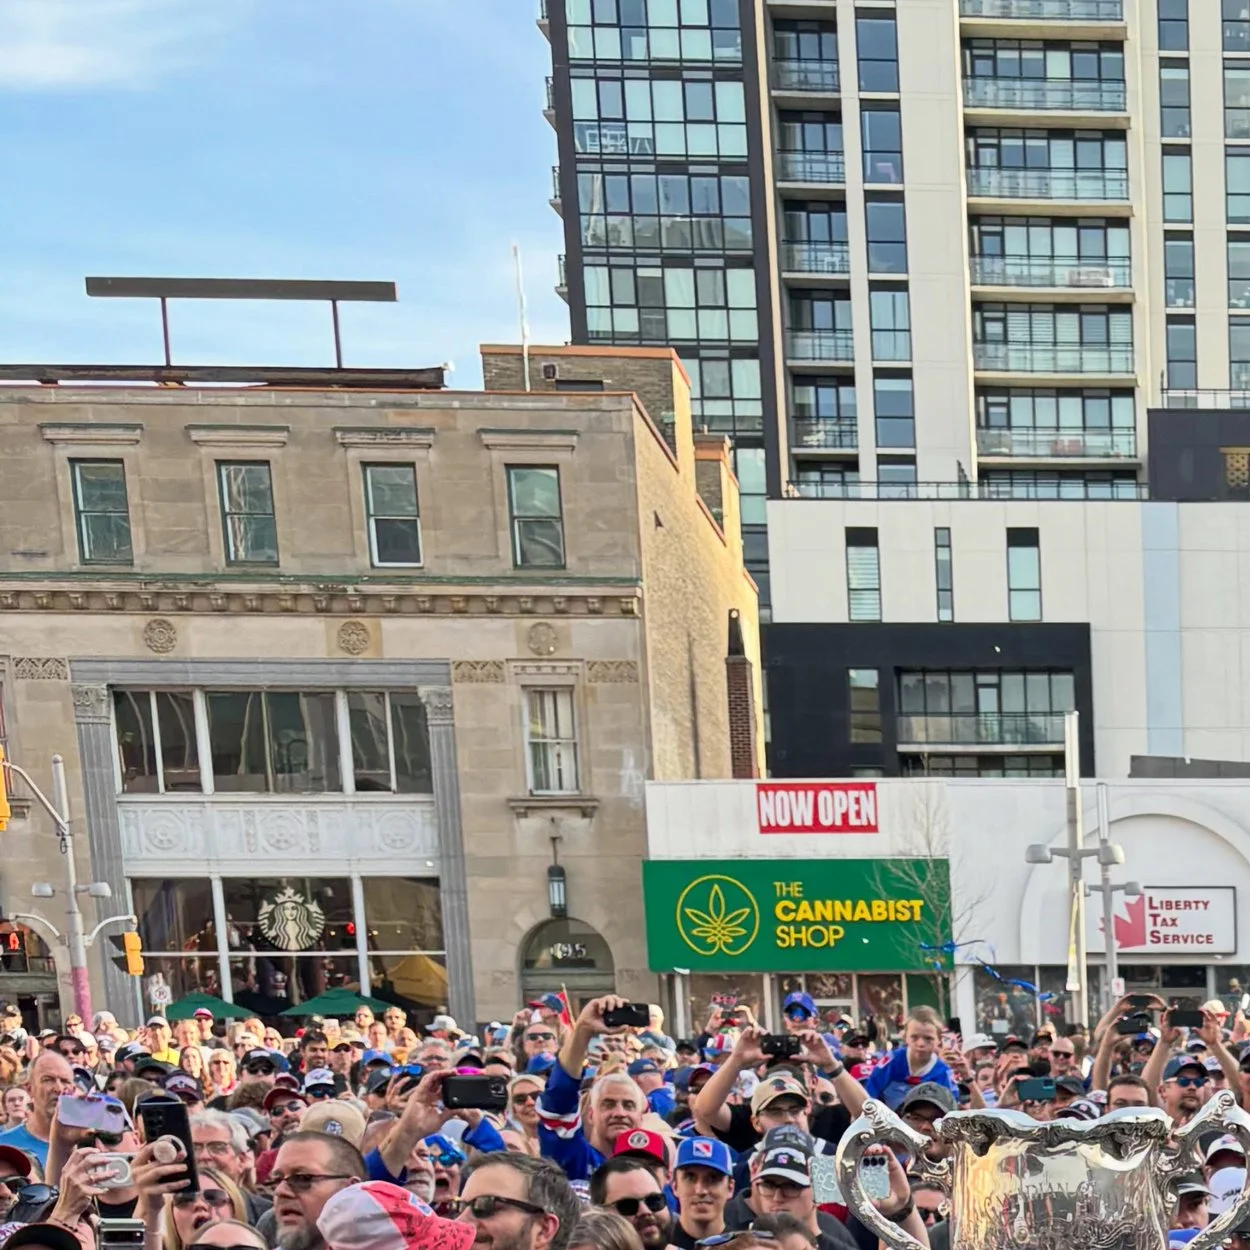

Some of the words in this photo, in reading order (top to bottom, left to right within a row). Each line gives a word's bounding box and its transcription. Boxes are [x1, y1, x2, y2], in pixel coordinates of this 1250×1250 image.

[760, 790, 813, 827] NOW
[818, 789, 876, 826] OPEN
[773, 881, 803, 898] THE
[774, 900, 924, 922] CANNABIST
[1148, 896, 1210, 910] LIBERTY
[1148, 913, 1179, 928] TAX
[775, 925, 846, 949] SHOP
[1149, 930, 1214, 945] SERVICE
